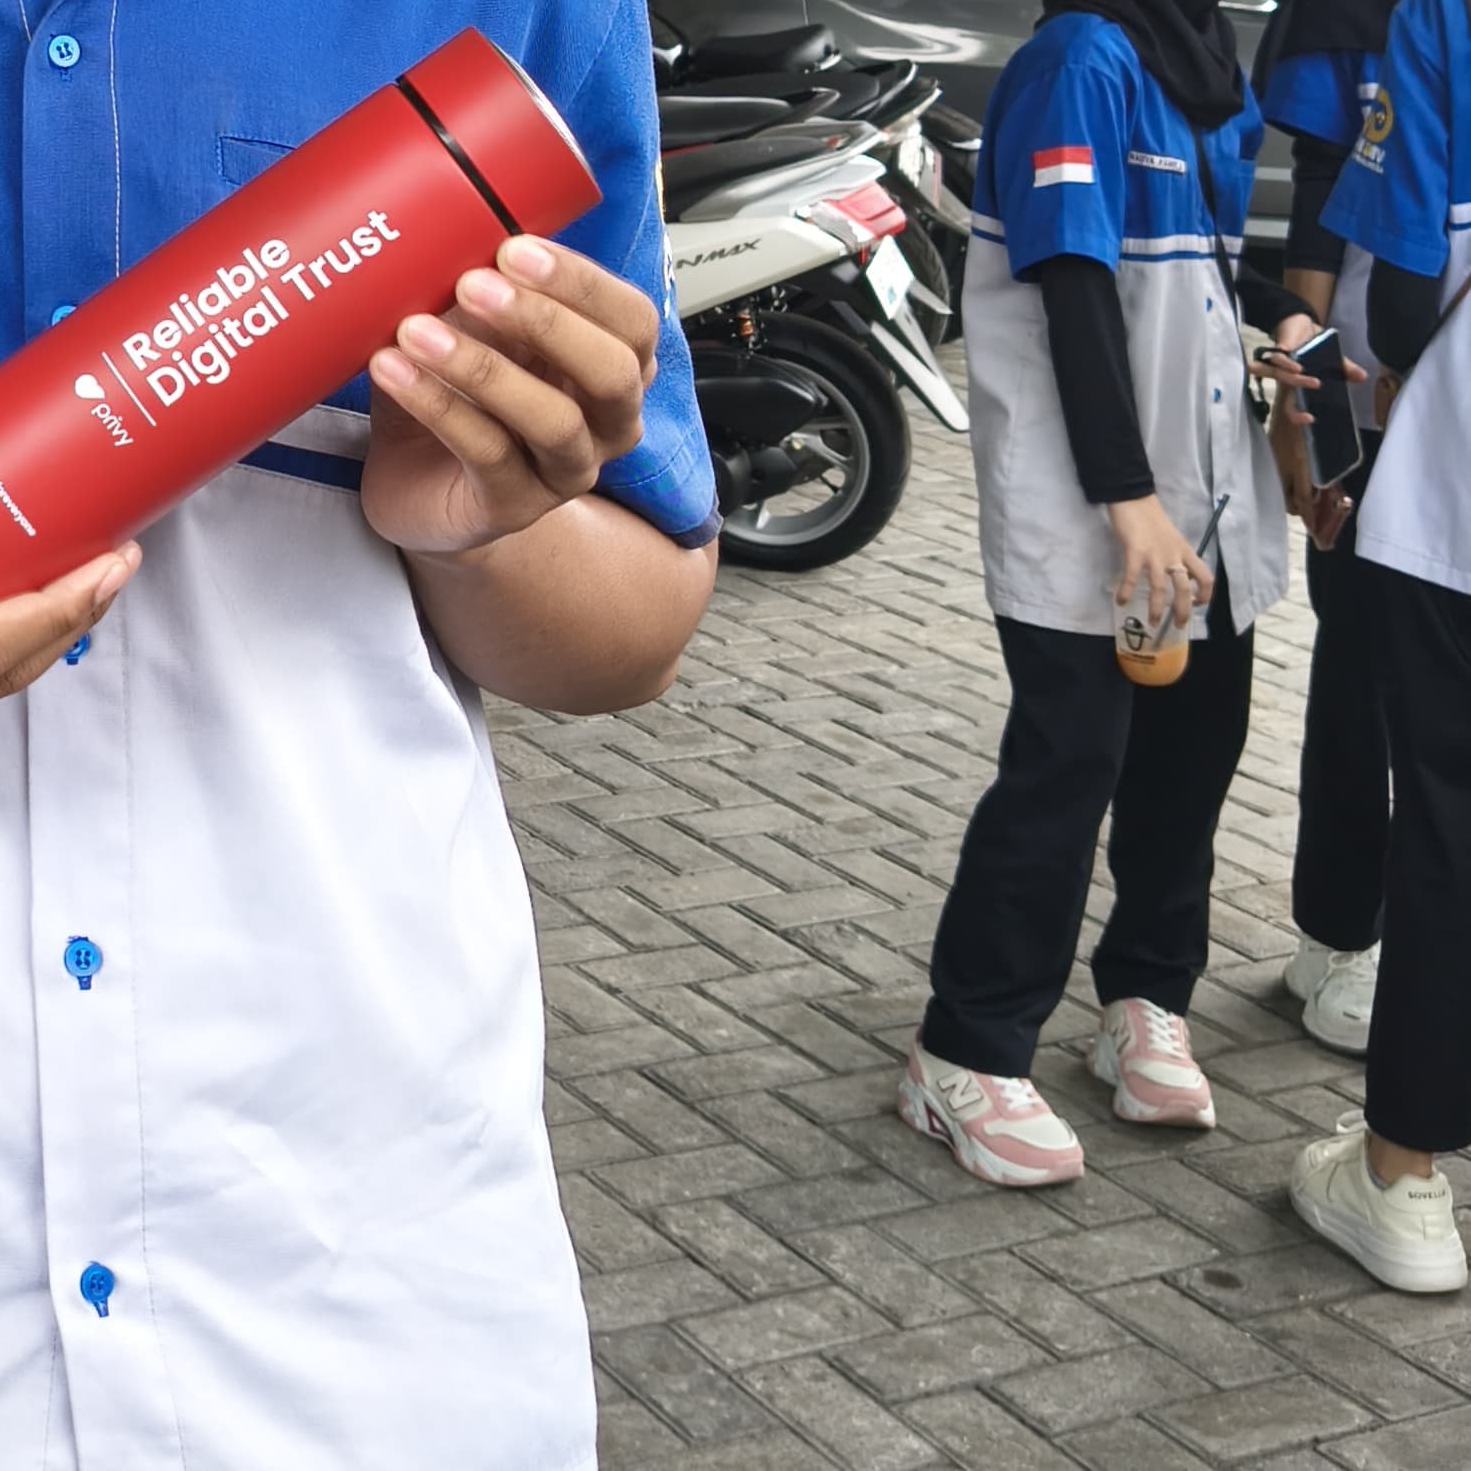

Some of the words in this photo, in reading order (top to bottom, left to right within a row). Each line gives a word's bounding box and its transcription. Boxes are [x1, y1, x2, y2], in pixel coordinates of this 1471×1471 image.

[122, 239, 291, 371] Reliable
[145, 286, 290, 407] Digital
[280, 210, 401, 302] Trust
[91, 403, 134, 447] privy
